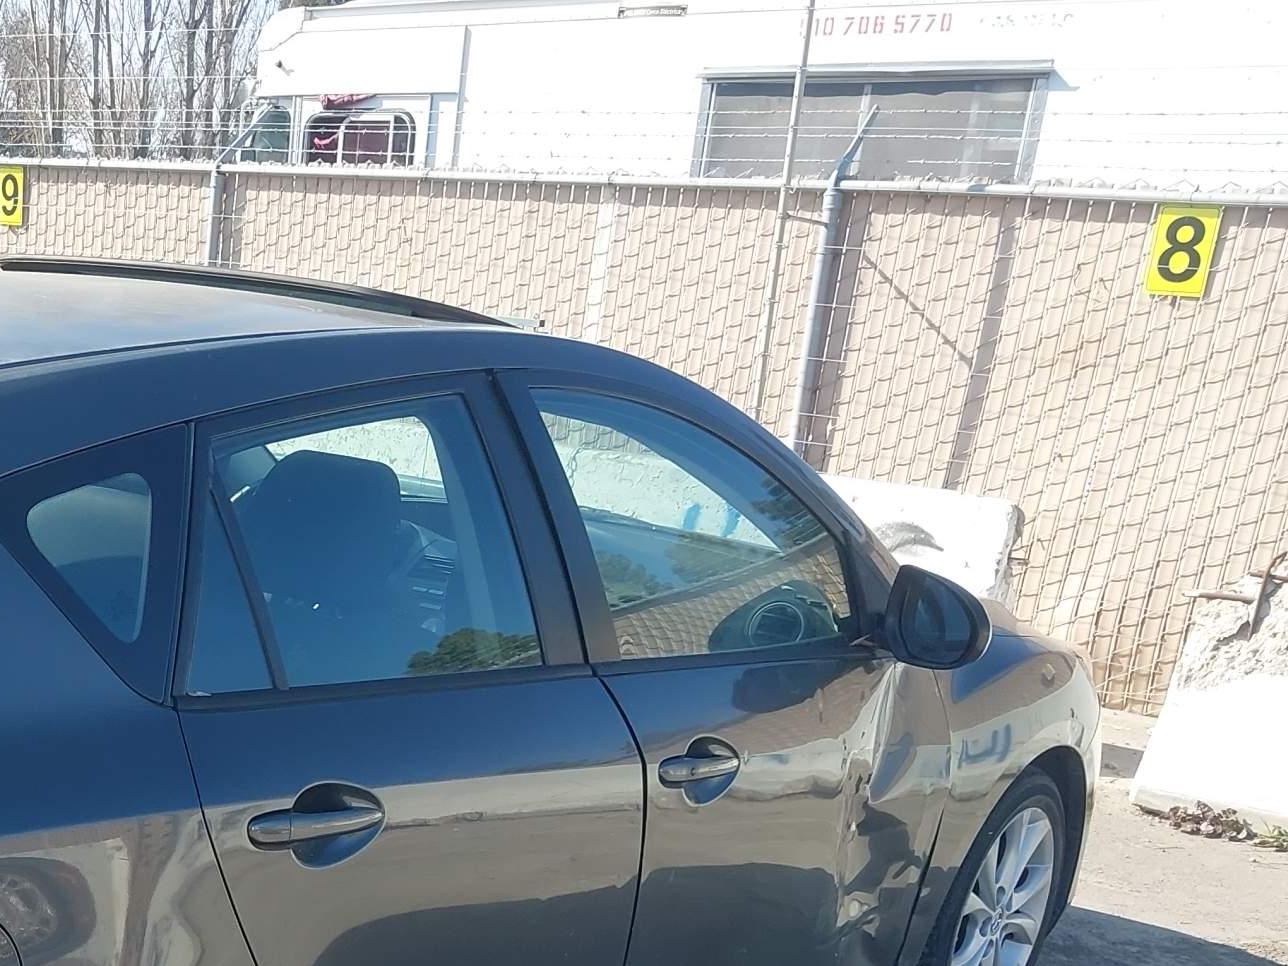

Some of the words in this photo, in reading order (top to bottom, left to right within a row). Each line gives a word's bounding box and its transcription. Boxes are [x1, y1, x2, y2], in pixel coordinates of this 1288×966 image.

[843, 15, 885, 35] 706
[893, 13, 953, 33] 5770
[1, 173, 19, 216] 9
[1157, 216, 1206, 283] 8
